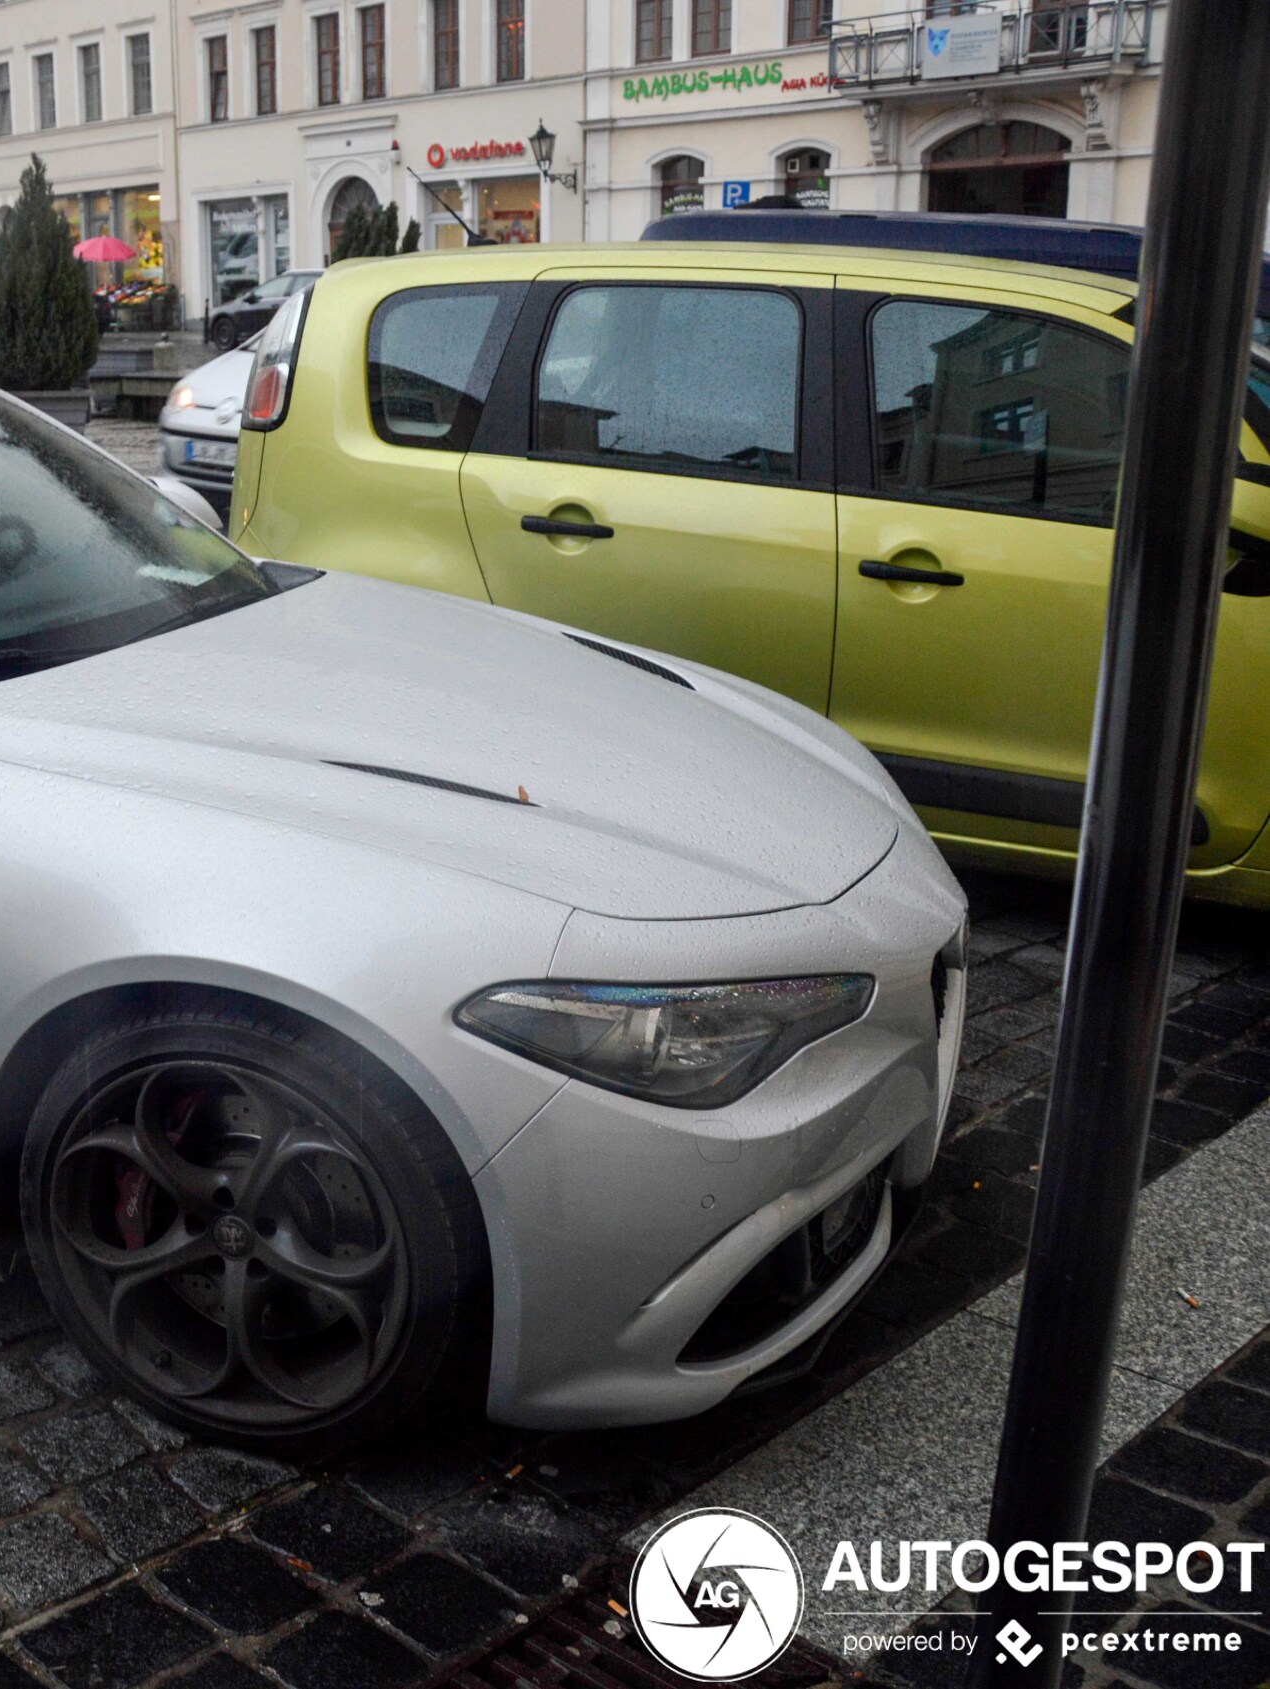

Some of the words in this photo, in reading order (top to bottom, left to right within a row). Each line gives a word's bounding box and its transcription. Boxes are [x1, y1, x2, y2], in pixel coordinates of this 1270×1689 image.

[623, 62, 783, 102] BAMBUS-HAUS
[781, 78, 807, 93] ASIA
[450, 139, 524, 161] vodafone
[726, 183, 742, 205] P
